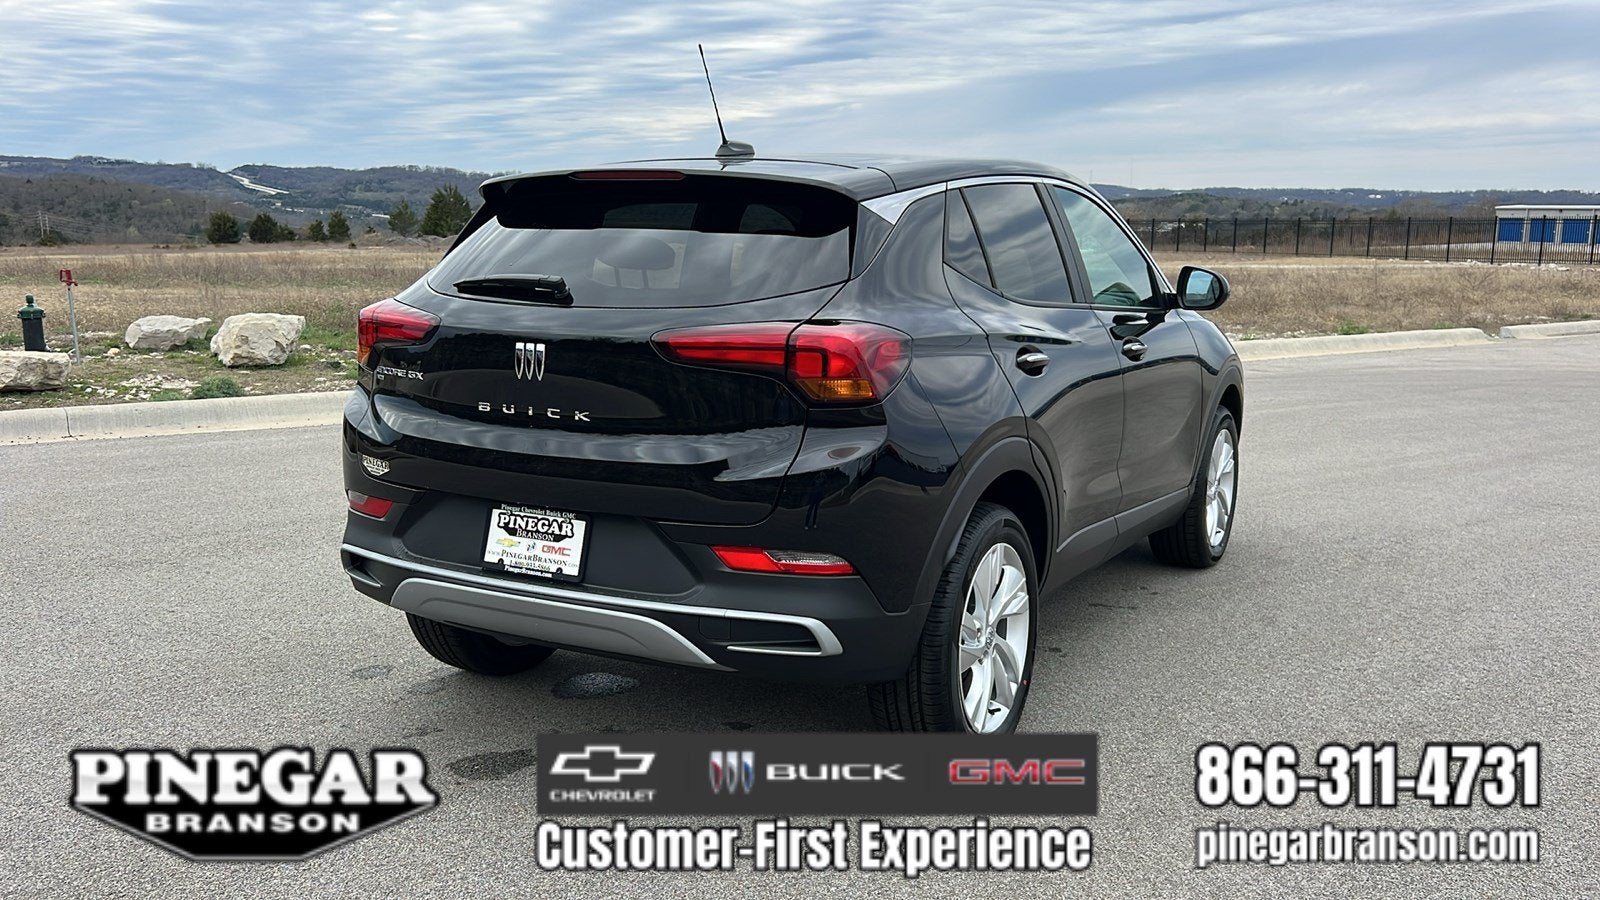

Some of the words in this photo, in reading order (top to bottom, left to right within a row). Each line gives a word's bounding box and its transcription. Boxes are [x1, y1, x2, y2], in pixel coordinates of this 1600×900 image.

[407, 370, 424, 381] GX
[478, 401, 591, 422] BUICK
[501, 504, 521, 514] Pinegar
[521, 506, 545, 516] Chevrolet
[546, 510, 561, 518] Buick
[562, 511, 577, 520] GMC
[499, 514, 574, 537] PINEGAR
[516, 528, 555, 542] BRANSON
[541, 544, 571, 557] GMC
